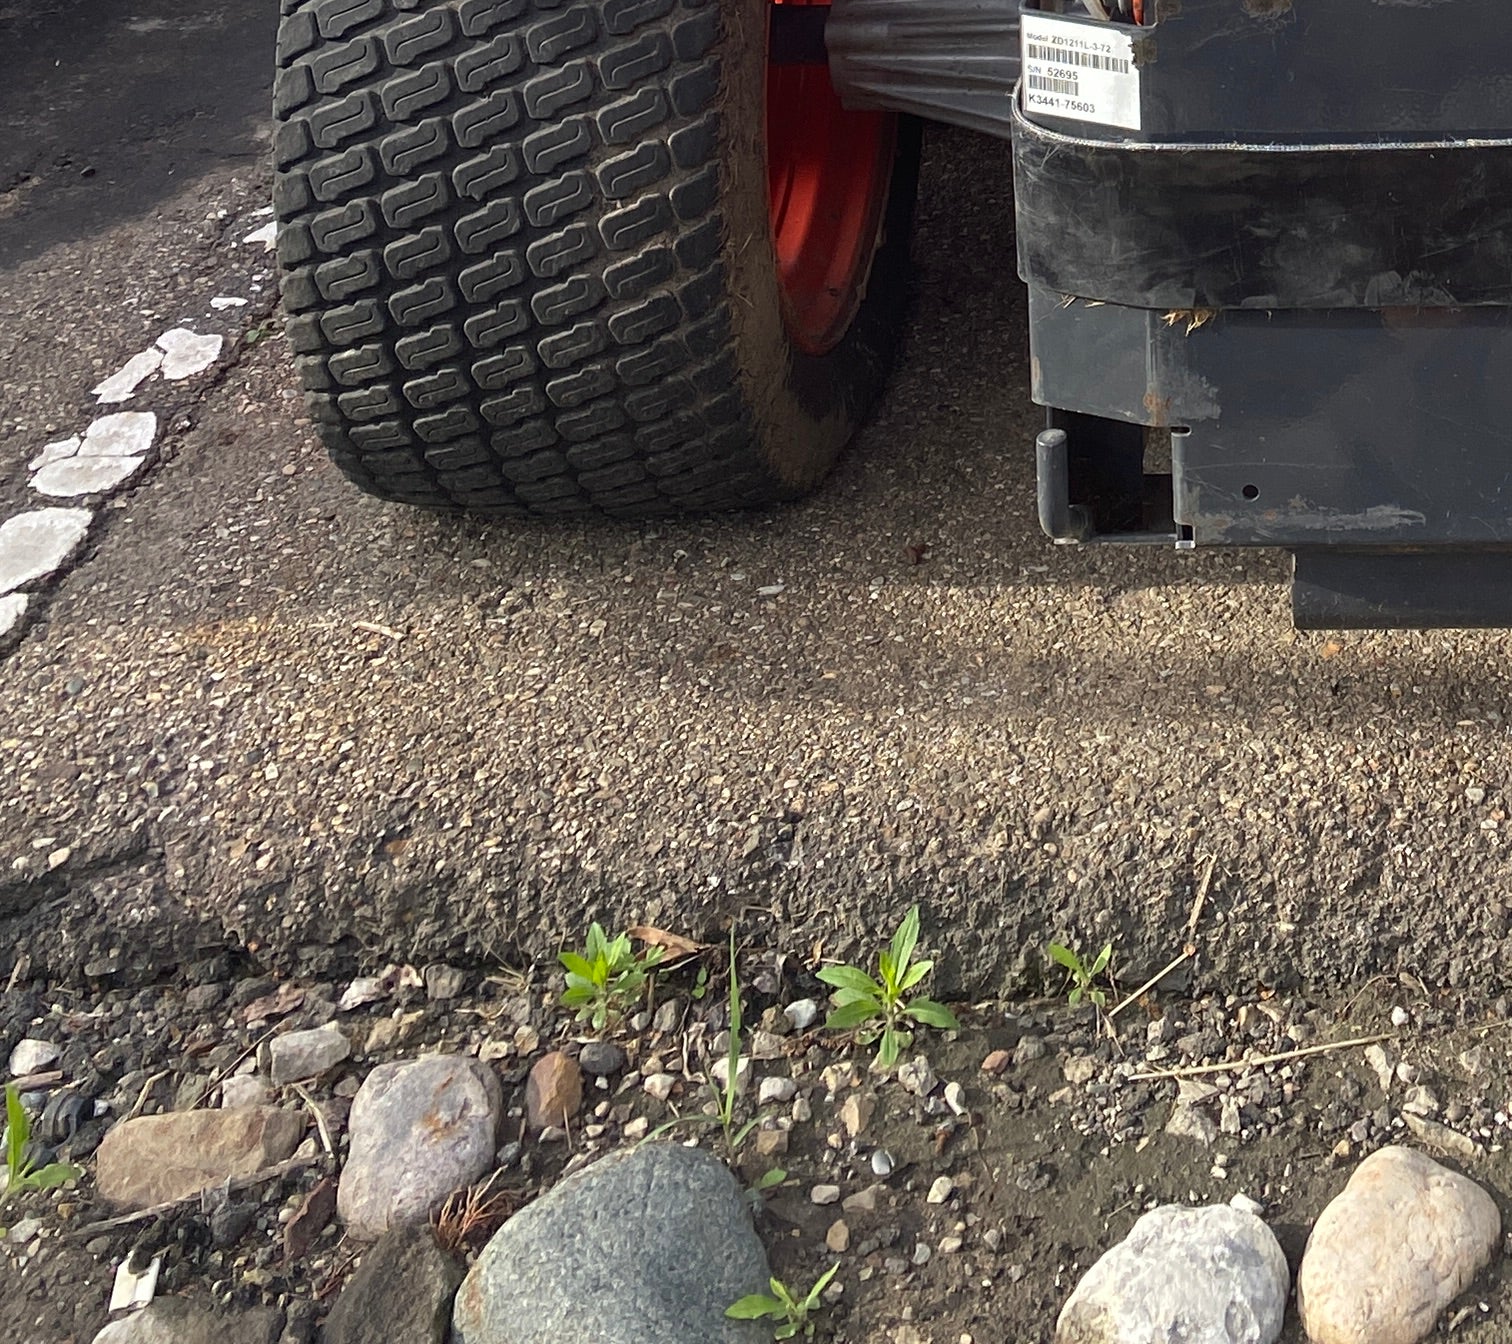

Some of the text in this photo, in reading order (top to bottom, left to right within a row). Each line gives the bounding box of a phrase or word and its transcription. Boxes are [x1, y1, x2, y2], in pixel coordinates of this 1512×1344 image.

[1051, 35, 1112, 53] ZD1211L-3-72
[1047, 67, 1079, 81] 52695
[1028, 93, 1096, 113] K3441-75603
